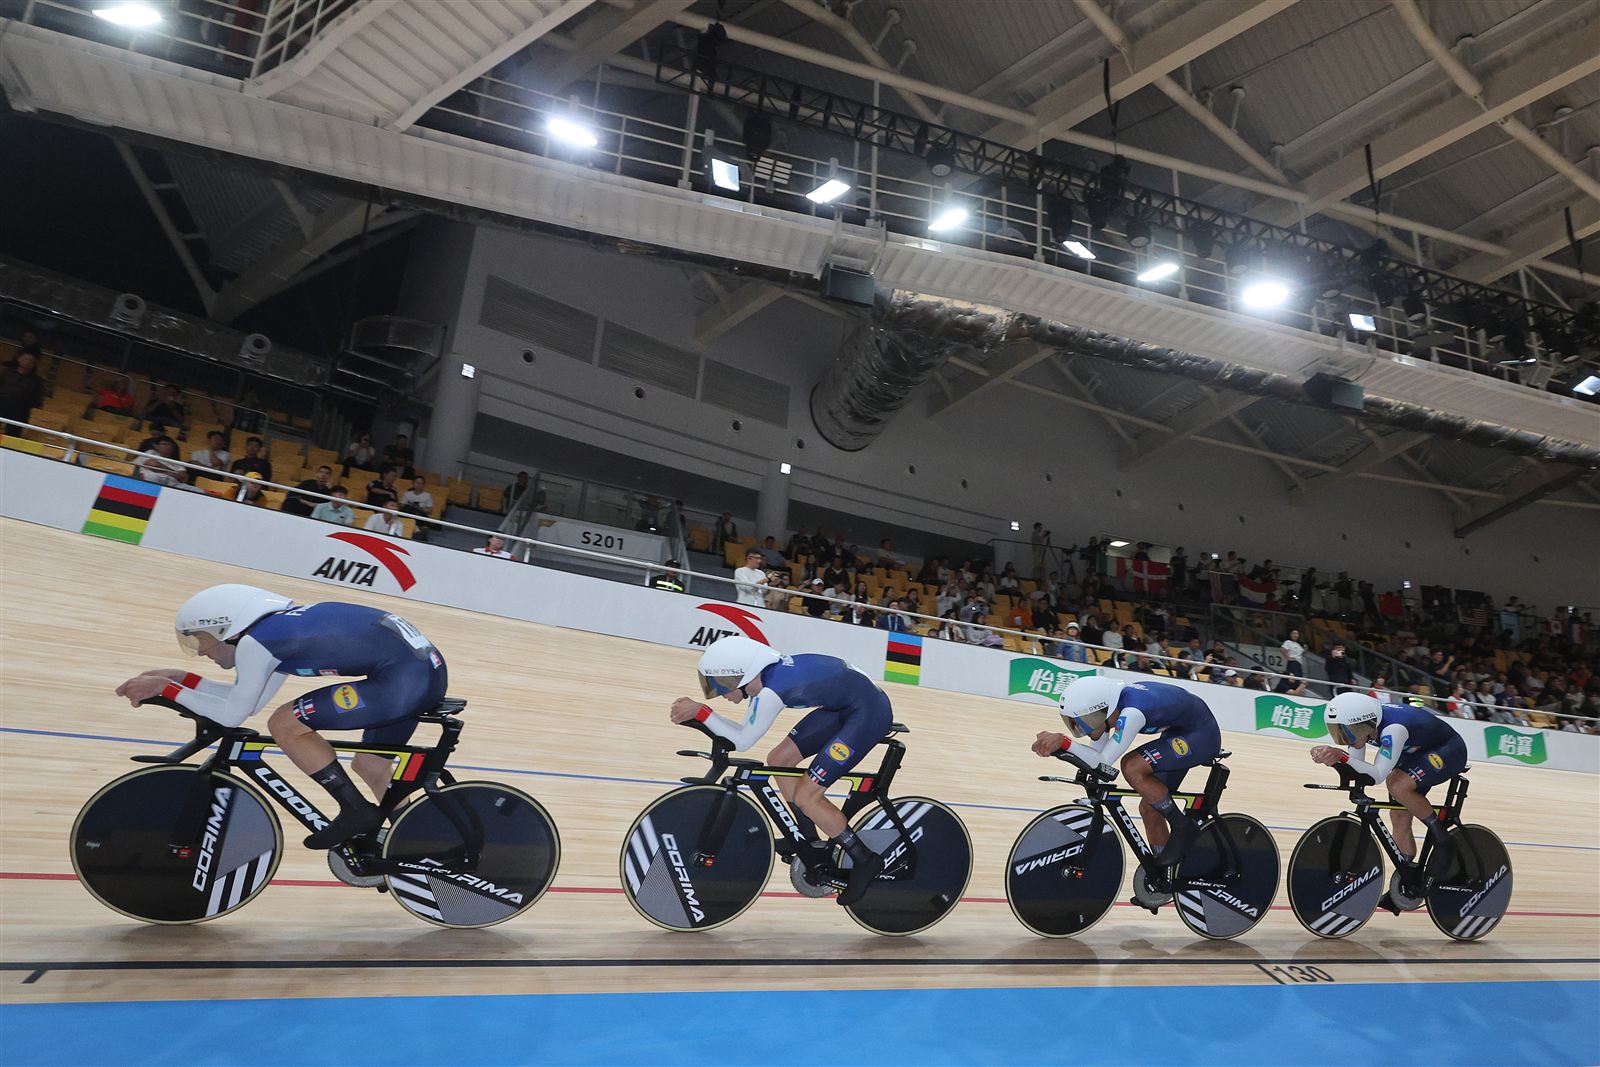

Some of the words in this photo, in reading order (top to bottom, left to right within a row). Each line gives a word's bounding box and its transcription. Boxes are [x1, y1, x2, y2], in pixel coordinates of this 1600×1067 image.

[581, 531, 624, 551] S201
[312, 556, 379, 587] ANTA
[688, 626, 741, 647] ANT
[1271, 704, 1314, 731] 怡寶
[1499, 734, 1534, 757] 怡寶
[255, 767, 329, 831] LOOK
[762, 786, 806, 842] LOOK
[192, 787, 232, 892] CORIMA
[1116, 806, 1151, 856] LOOK
[1376, 818, 1404, 863] LOOK
[398, 862, 431, 872] LOOK
[419, 857, 523, 905] RIMA
[661, 833, 705, 923] CORIMA
[1204, 886, 1258, 918] RIMA
[1321, 865, 1380, 912] CORIMA
[1273, 965, 1335, 983] 130
